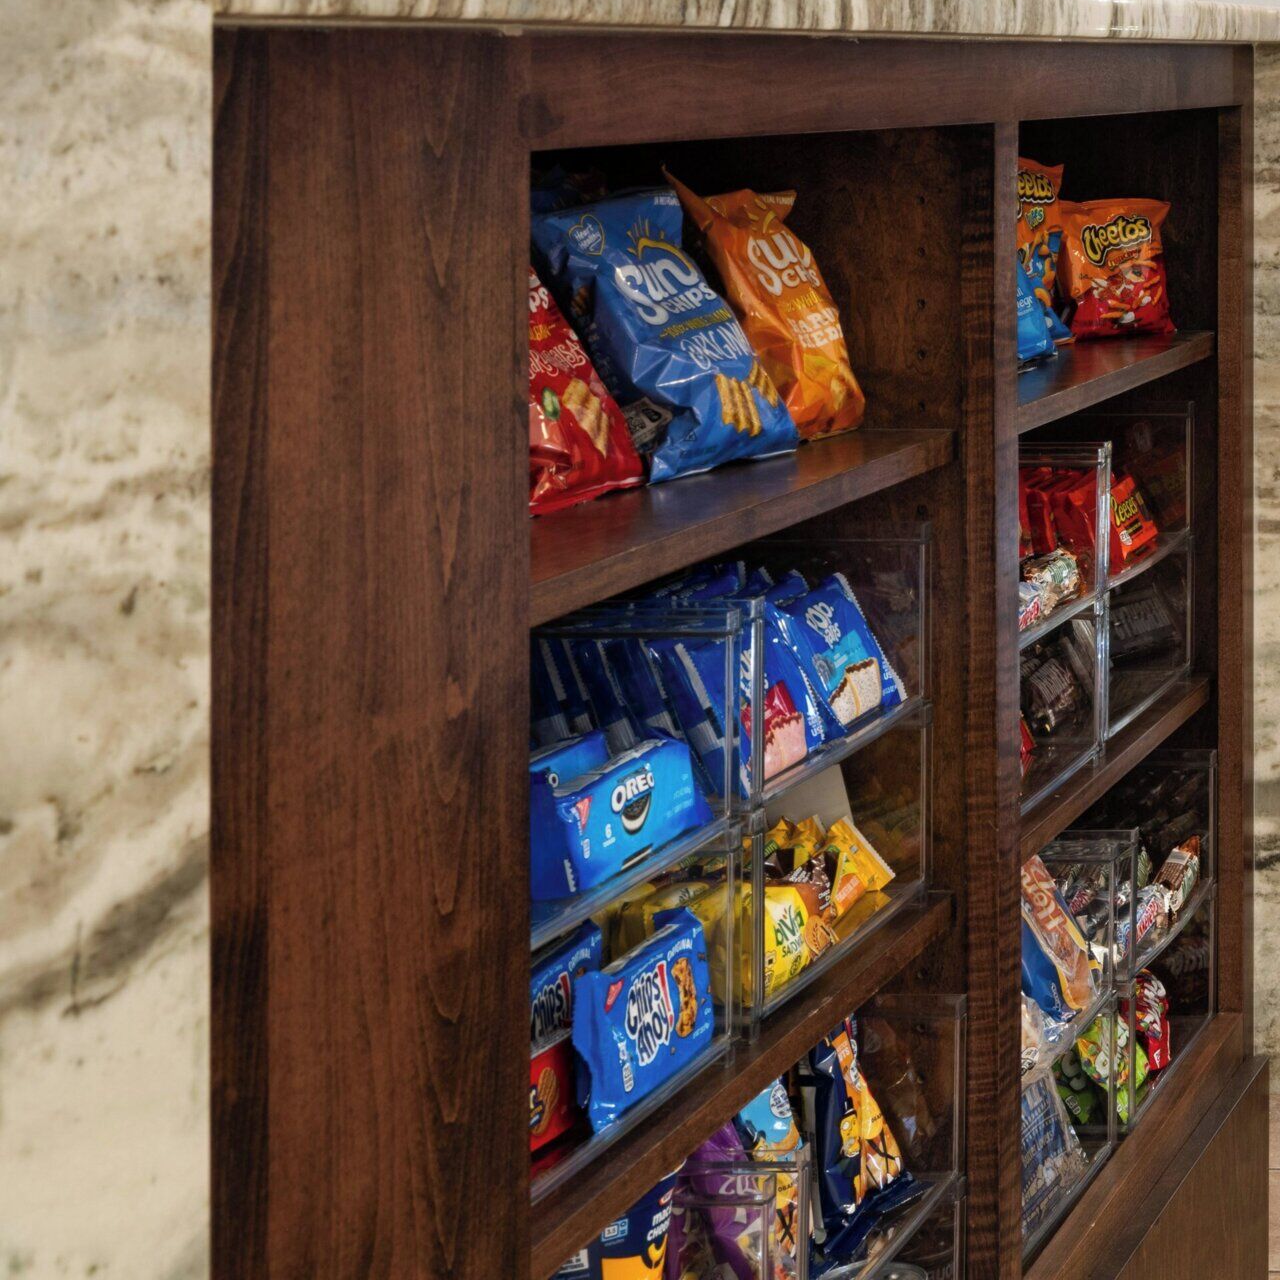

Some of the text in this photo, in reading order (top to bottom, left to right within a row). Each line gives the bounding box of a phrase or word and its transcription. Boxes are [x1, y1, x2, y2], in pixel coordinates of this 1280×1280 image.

[1018, 174, 1052, 198] eetos
[1083, 218, 1149, 261] Cheetos
[615, 259, 700, 326] Sun
[662, 283, 718, 314] CHIPS
[680, 322, 753, 370] ORIGIN
[611, 772, 655, 813] OREO
[604, 823, 613, 839] 6
